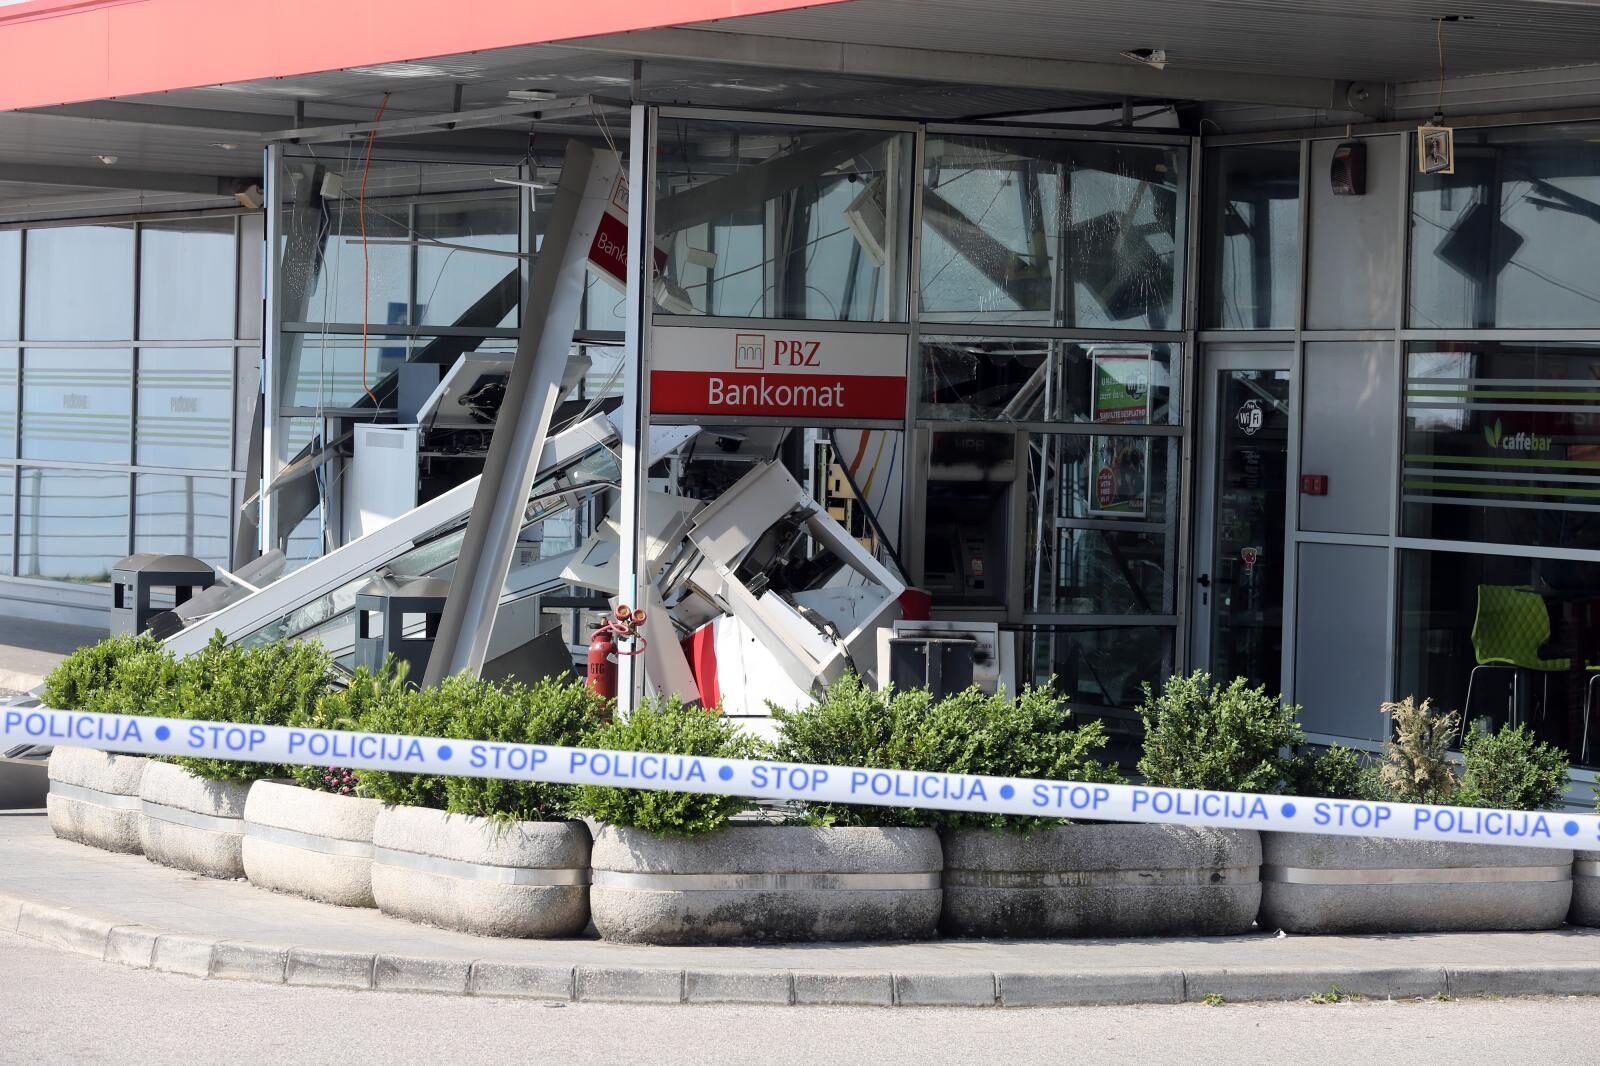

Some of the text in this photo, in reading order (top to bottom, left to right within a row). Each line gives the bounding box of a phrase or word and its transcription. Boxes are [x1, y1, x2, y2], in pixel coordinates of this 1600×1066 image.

[597, 232, 628, 267] Bank
[773, 340, 821, 367] PBZ
[708, 377, 845, 407] Bankomat
[1502, 432, 1552, 451] caffebar
[5, 711, 1552, 839] POLICIJA STOP POLICIJA STOP POLICIJA STOP POLICIJA STOP POLICIJA STOP POLICIJA
